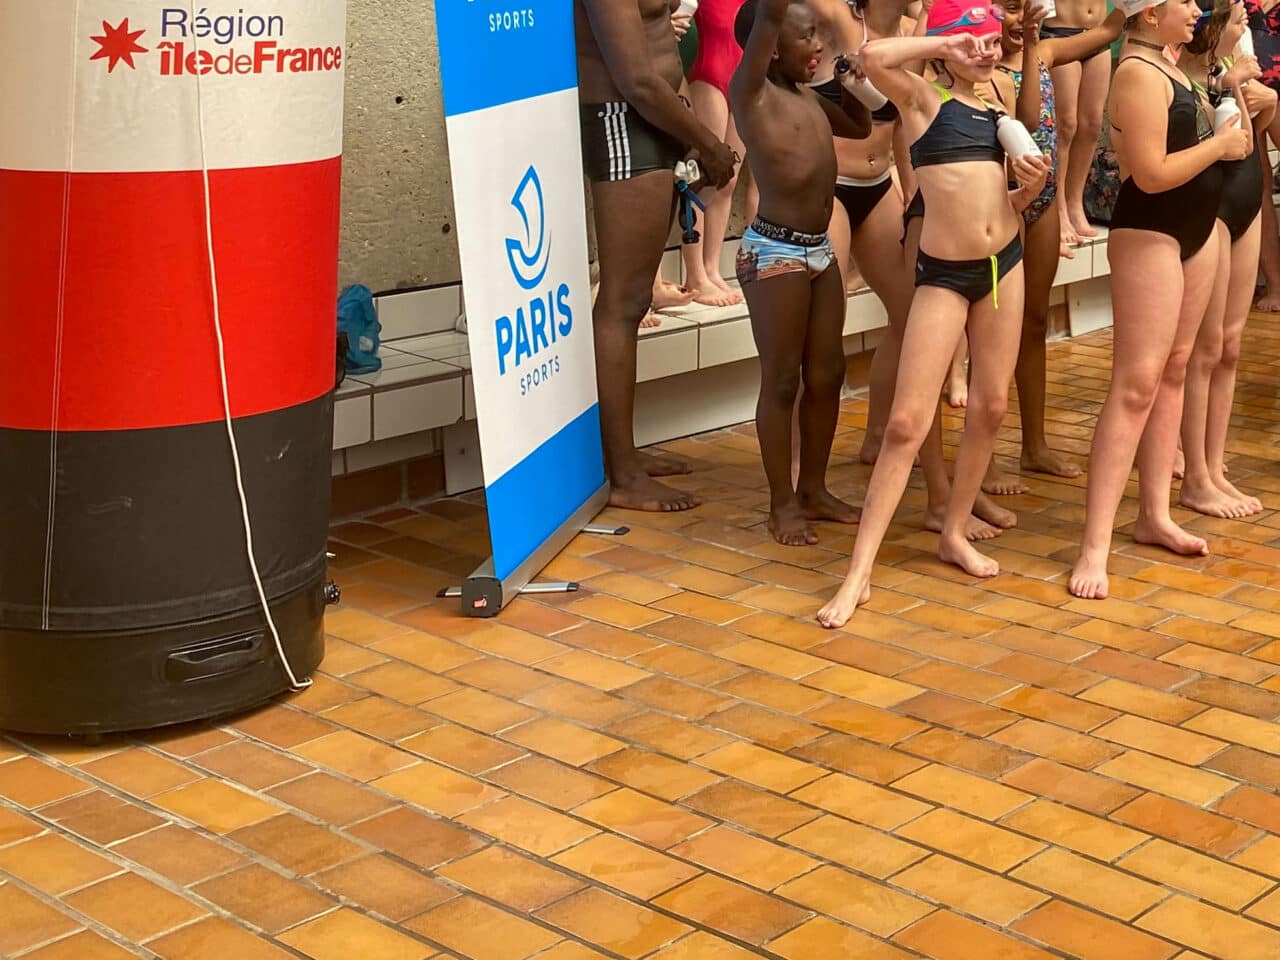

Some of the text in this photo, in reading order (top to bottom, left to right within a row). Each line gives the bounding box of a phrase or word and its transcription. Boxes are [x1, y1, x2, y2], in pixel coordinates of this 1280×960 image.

[161, 8, 284, 44] Région
[489, 9, 535, 32] SPORTS
[495, 283, 573, 376] PARIS
[520, 355, 560, 396] SPORTS
